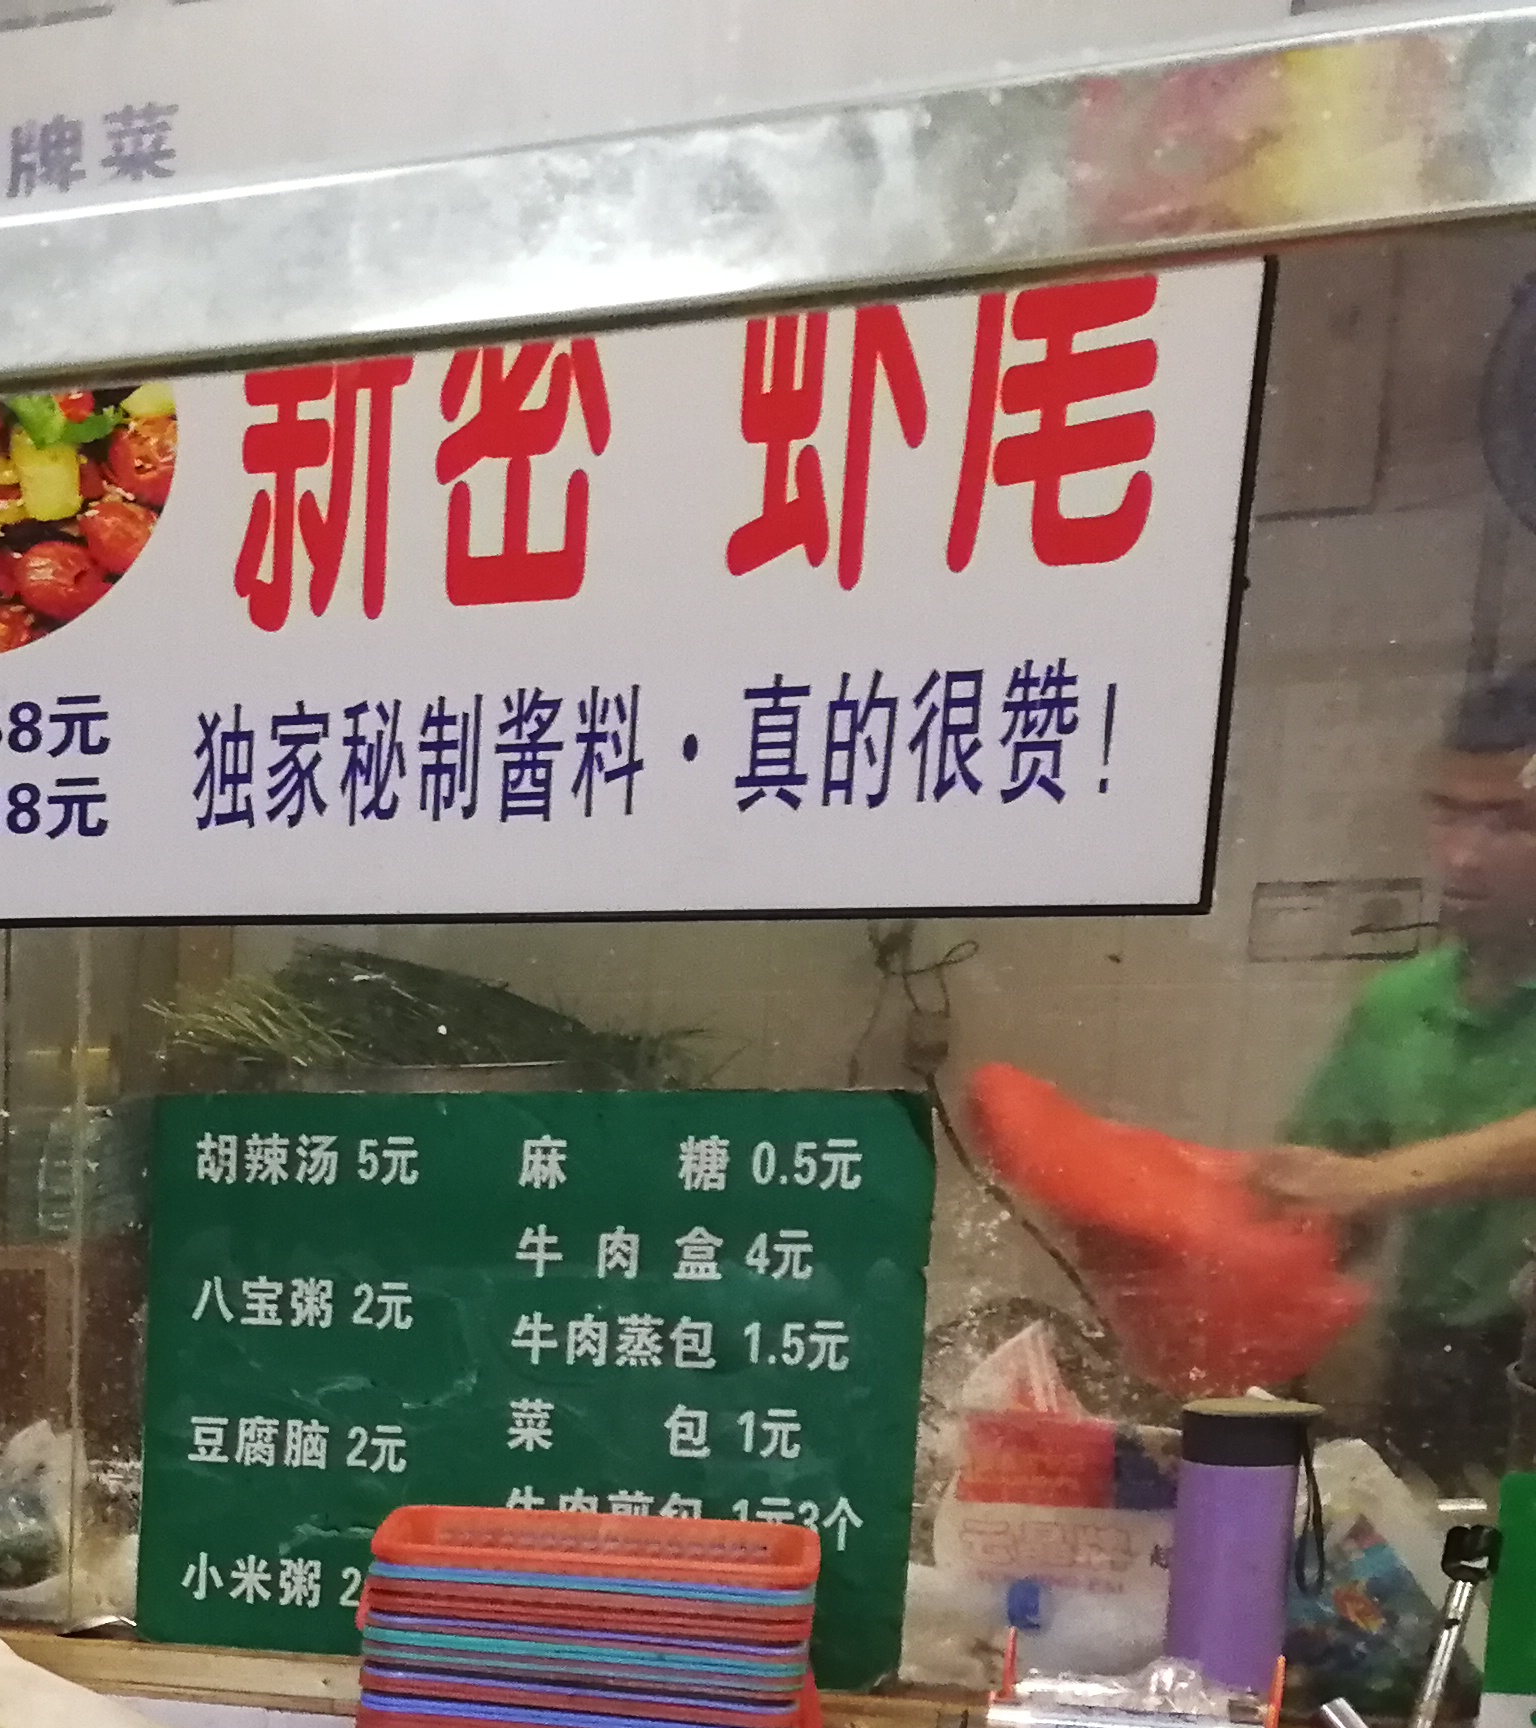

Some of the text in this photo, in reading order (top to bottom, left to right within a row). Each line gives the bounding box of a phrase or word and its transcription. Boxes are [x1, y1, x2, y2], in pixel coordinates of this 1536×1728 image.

[195, 1131, 420, 1187] 胡辣汤 5元
[751, 1137, 864, 1191] 0.5元
[744, 1228, 815, 1281] 4元
[190, 1274, 414, 1331] 八宝粥 2元
[509, 1310, 851, 1372] 牛肉蒸包 1.5元
[186, 1414, 408, 1474] 豆腐脑 2元
[735, 1407, 803, 1460] 1元
[180, 1550, 323, 1609] 小米粥
